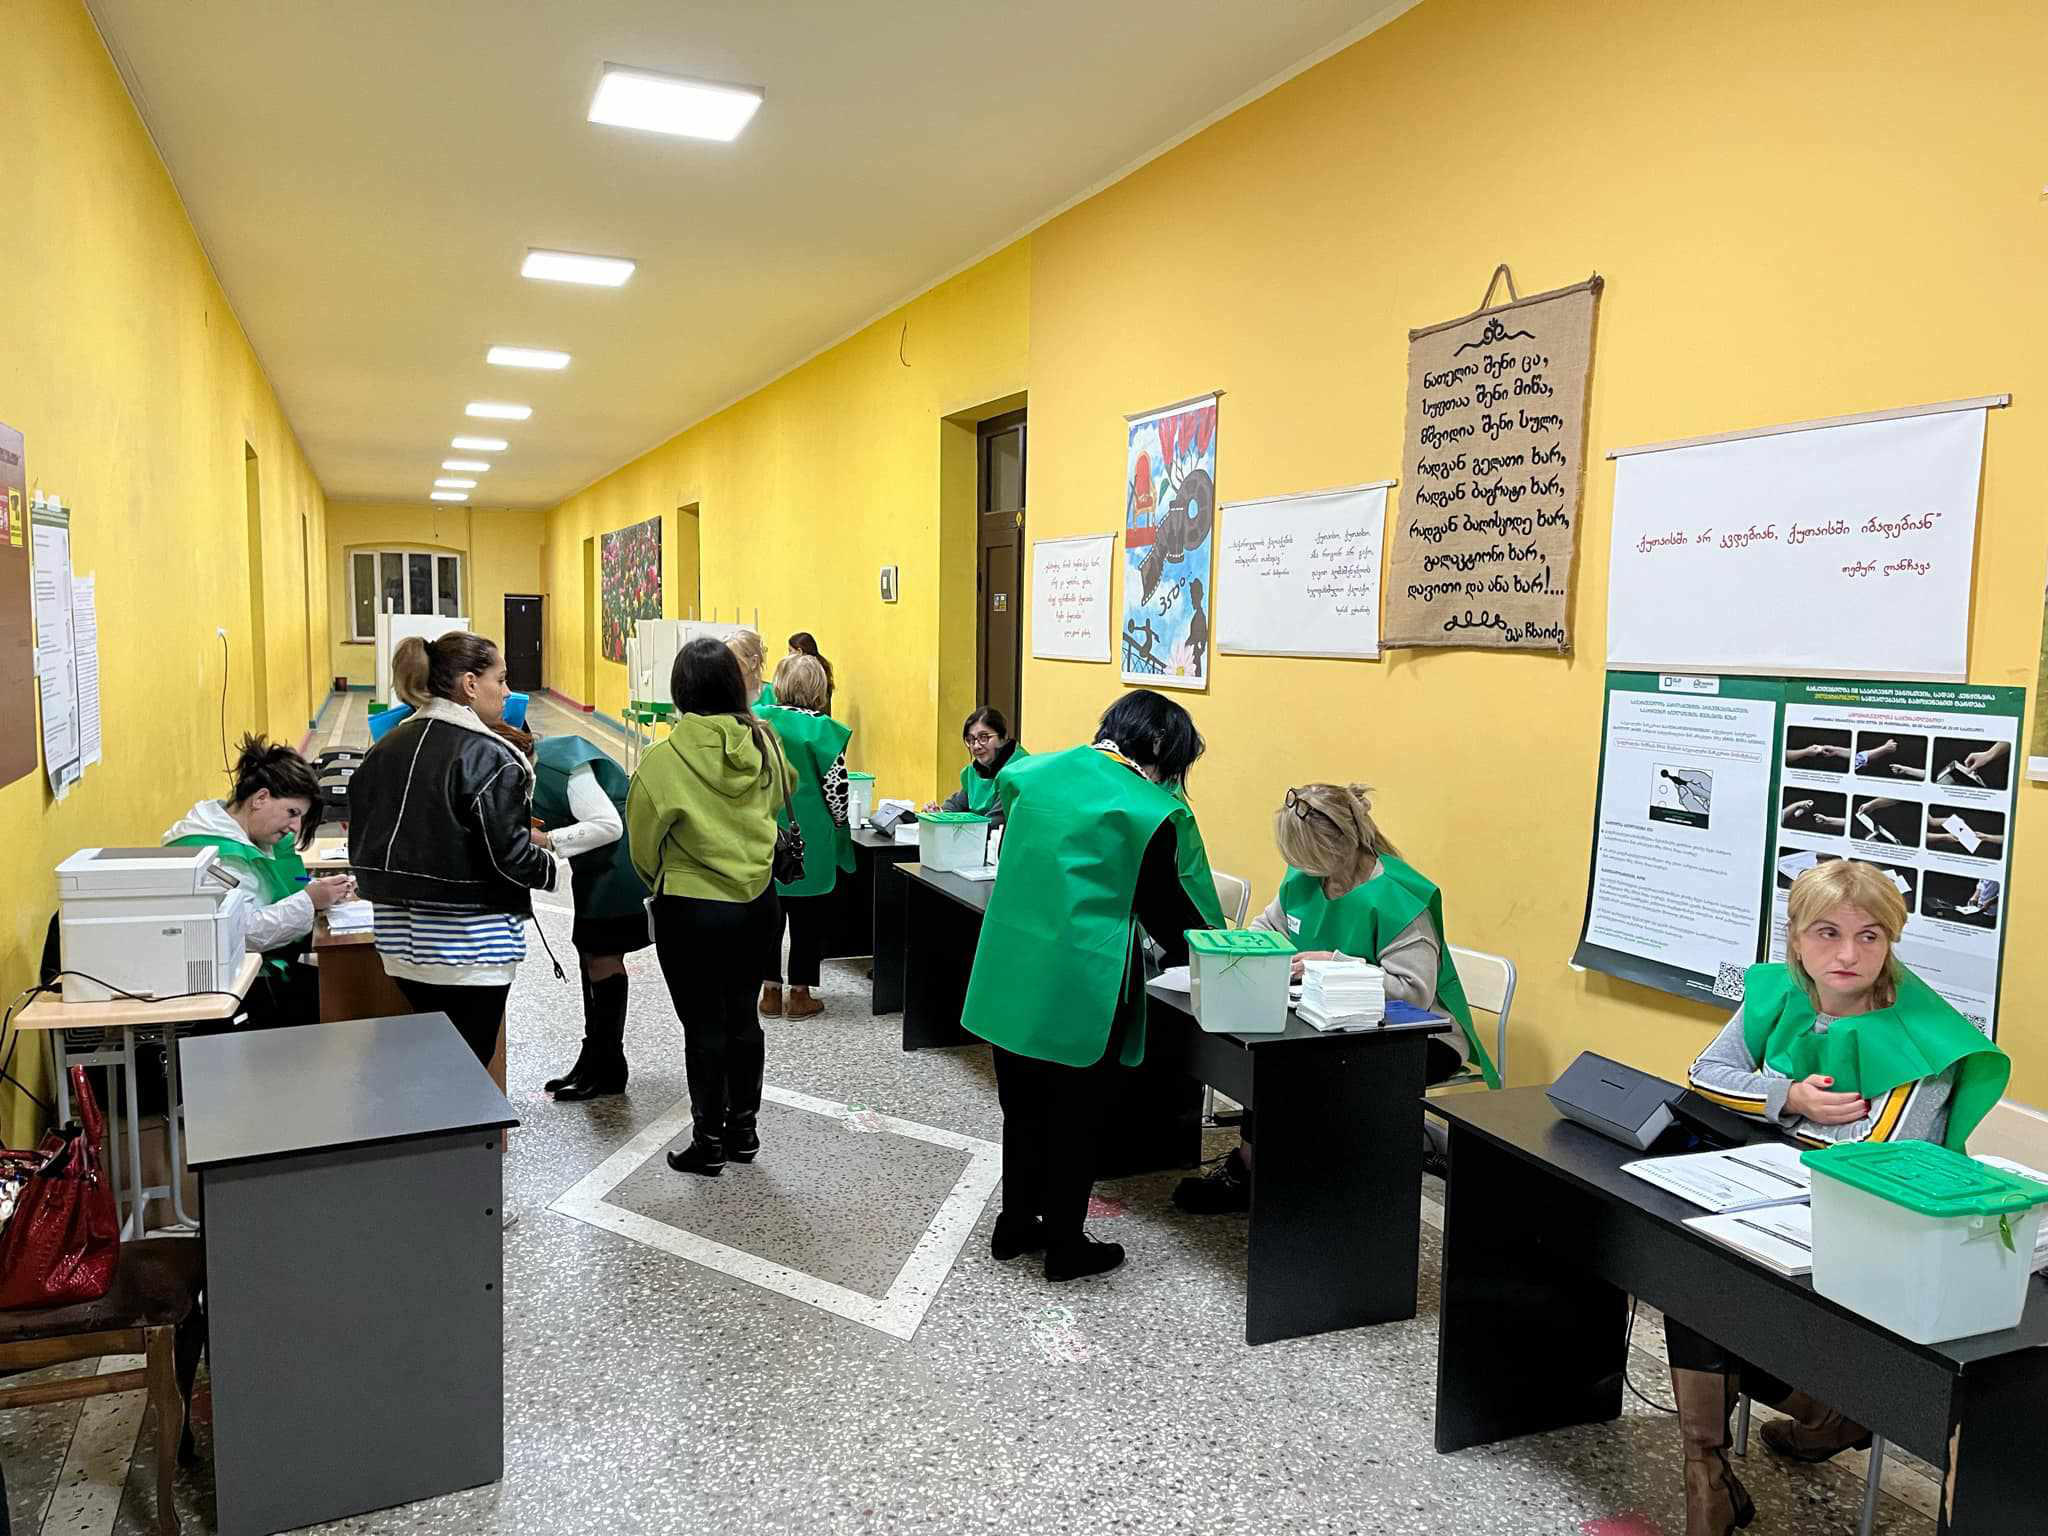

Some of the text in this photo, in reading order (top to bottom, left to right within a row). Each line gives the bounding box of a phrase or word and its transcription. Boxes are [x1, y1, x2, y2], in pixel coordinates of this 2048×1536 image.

[1423, 353, 1549, 389] ნათელია შენი ცა,
[1422, 374, 1553, 418] სუფთაა შენი მიწა,
[1420, 409, 1564, 449] მშვიდია შენი სული,
[1417, 441, 1566, 479] რადგან გელათი ხარ,
[1416, 472, 1564, 508] რადგან ბაგრატი ხარ,
[1409, 515, 1458, 543] რადგან
[1537, 504, 1569, 529] ხარ,
[1696, 528, 1713, 543] არ
[1719, 524, 1779, 549] კვდებიან,
[1787, 520, 1850, 545] ქუთაისში
[1424, 545, 1504, 571] გალაკტიონი
[1841, 560, 1877, 578] თემურ
[1408, 581, 1462, 602] დავითი
[1466, 583, 1484, 600] და
[1488, 575, 1509, 593] ანა
[1525, 621, 1565, 643] ჩხაიძე
